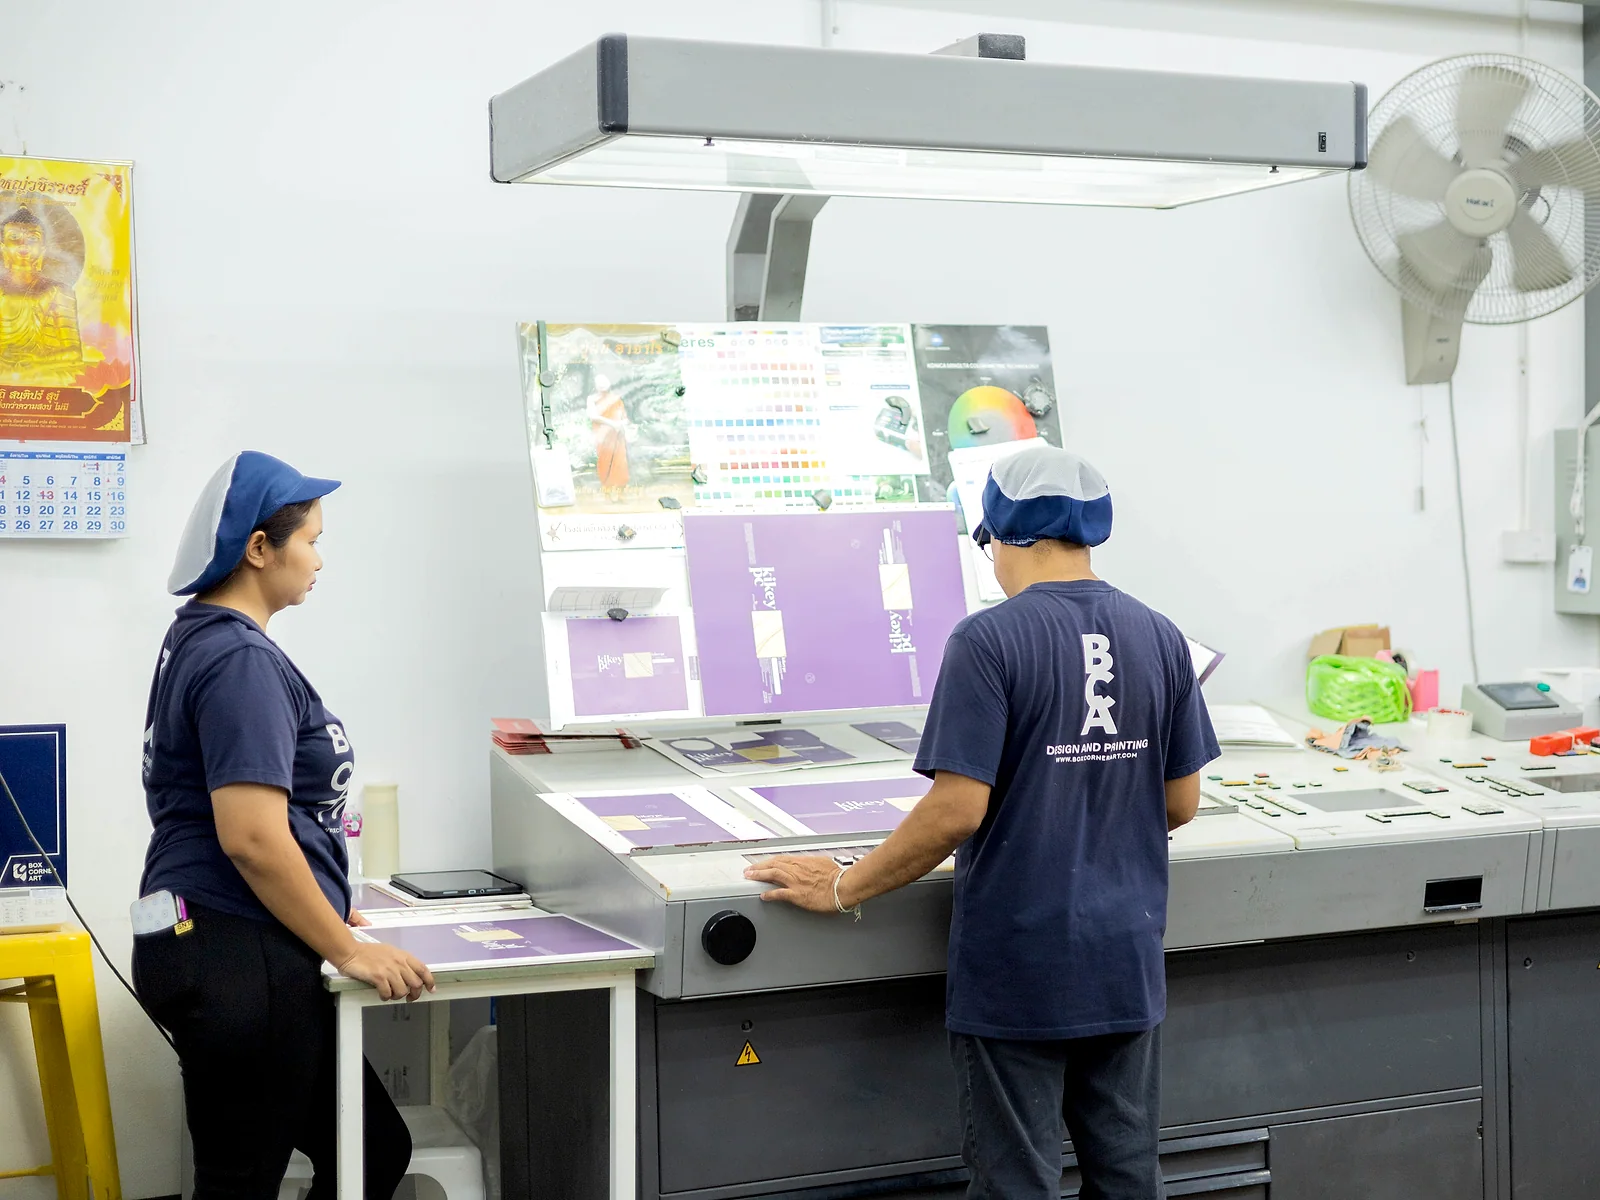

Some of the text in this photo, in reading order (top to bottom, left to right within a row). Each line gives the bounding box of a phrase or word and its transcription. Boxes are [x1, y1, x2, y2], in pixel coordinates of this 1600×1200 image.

[681, 338, 715, 348] eres
[117, 462, 125, 472] 2
[23, 475, 30, 485] 5
[46, 475, 54, 485] 6
[70, 476, 77, 486] 7
[93, 477, 101, 486] 8
[117, 477, 125, 486] 9
[16, 490, 30, 500] 12
[40, 490, 54, 500] 13
[63, 491, 78, 500] 14
[87, 491, 101, 501] 15
[110, 491, 125, 501] 16
[16, 505, 30, 515] 19
[39, 505, 54, 515] 20
[63, 505, 76, 515] 21
[87, 506, 101, 515] 22
[110, 506, 125, 516] 23
[15, 520, 31, 530] 26
[39, 520, 54, 530] 27
[63, 520, 78, 530] 28
[87, 520, 101, 530] 29
[110, 520, 125, 530] 30
[748, 566, 763, 587] pc
[762, 566, 777, 610] kikey
[889, 610, 903, 653] kikey
[1080, 633, 1118, 736] BCA
[1081, 743, 1102, 753] AND
[1104, 739, 1149, 752] PRINTING
